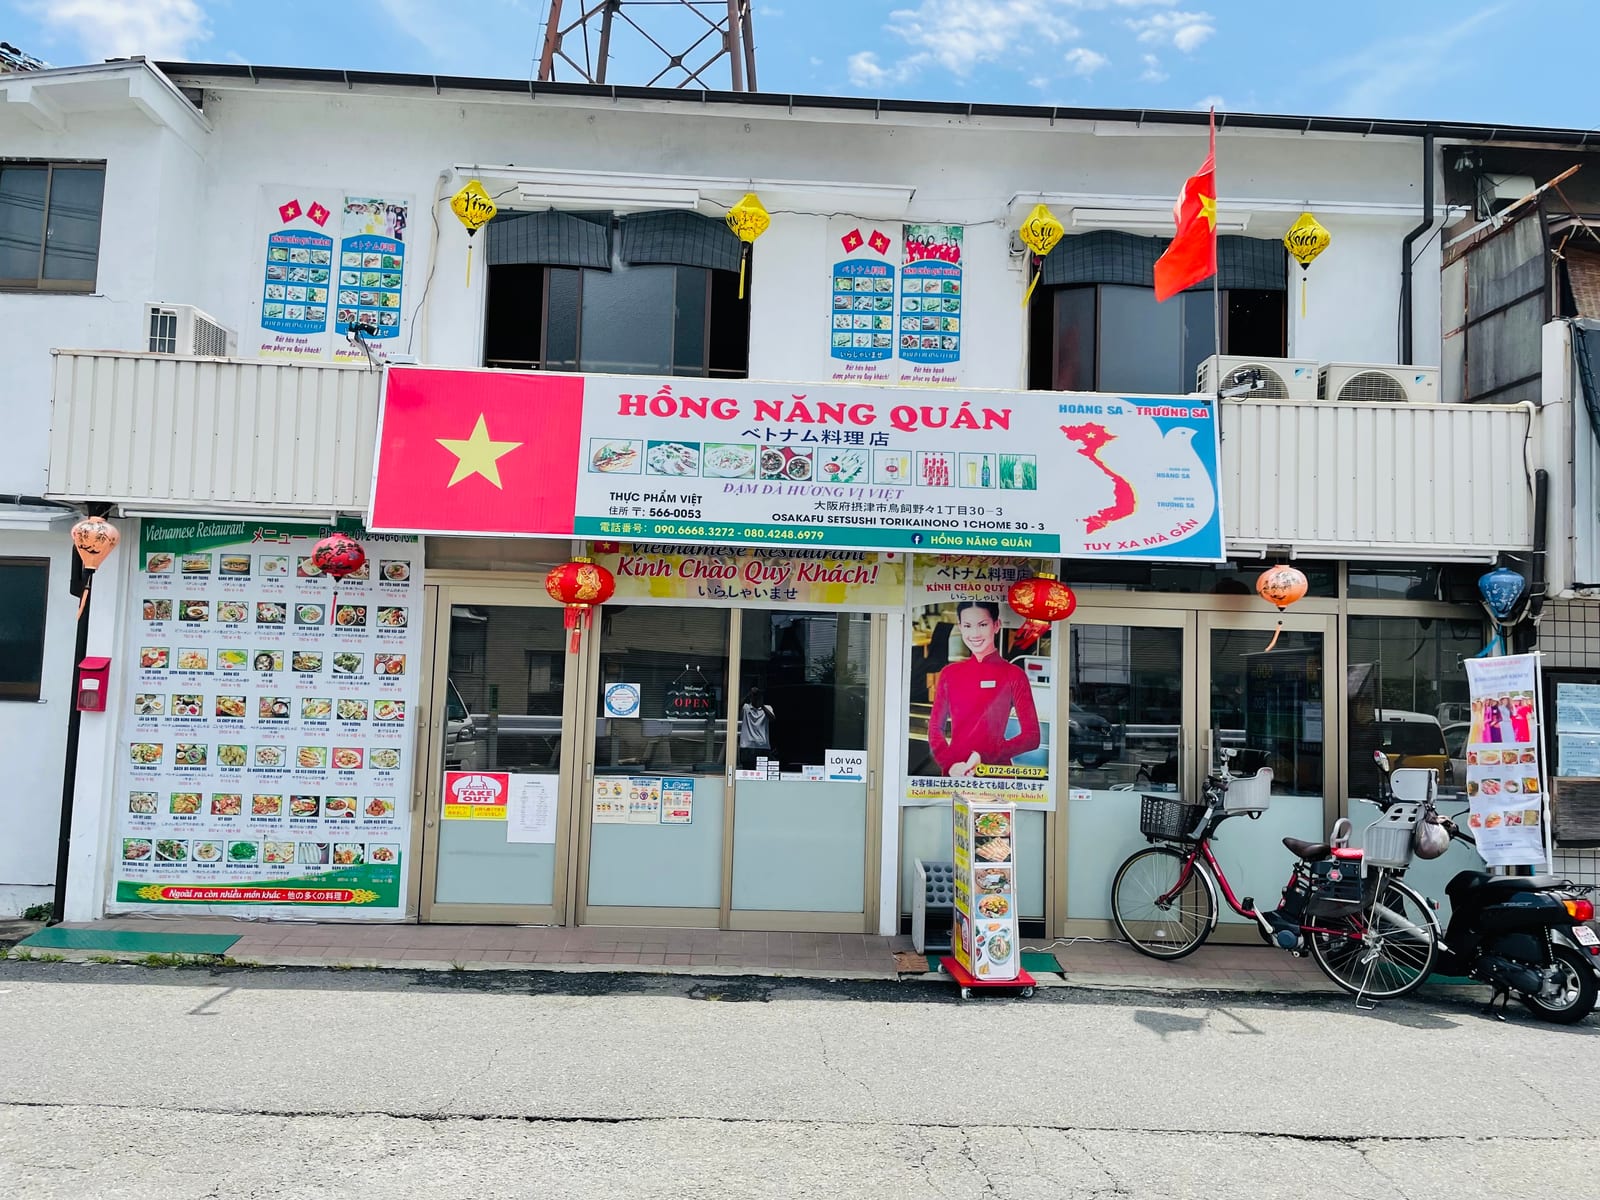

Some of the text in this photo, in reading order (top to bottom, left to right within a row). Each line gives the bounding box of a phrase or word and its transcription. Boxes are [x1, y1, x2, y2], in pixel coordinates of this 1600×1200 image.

[617, 384, 1012, 432] HỒNG NĂNG QUÁN
[1106, 405, 1123, 415] SA
[1192, 408, 1208, 418] SA
[741, 427, 890, 446] ベトナム料理店
[609, 490, 703, 507] THỰC PHẨM VIỆT
[649, 508, 702, 519] 566-0053
[771, 513, 824, 524] OSAKAFU
[827, 514, 876, 525] SETSUSHI
[880, 516, 959, 528] TORIKAINONO
[963, 519, 1011, 530] 1CHOME
[1014, 521, 1028, 530] 30
[1038, 522, 1045, 531] 3
[146, 522, 246, 542] Vietnamese Restaurant
[251, 526, 308, 545] メニュー
[654, 524, 735, 537] 090.6668.3272
[744, 528, 824, 540] 080.4248.6979
[1000, 536, 1032, 548] QUÁN
[1084, 542, 1111, 551] TUY
[1118, 540, 1140, 550] XA
[631, 542, 747, 558] Vietnamese
[616, 556, 879, 586] Kính Chào Quý Khách!
[926, 582, 1004, 592] KÍNH CHÀO QUÝ
[950, 592, 1008, 602] いらっしゃいま
[674, 698, 711, 709] OPEN
[989, 768, 1042, 776] 072-646-6137
[243, 890, 260, 900] món
[262, 890, 280, 900] khác
